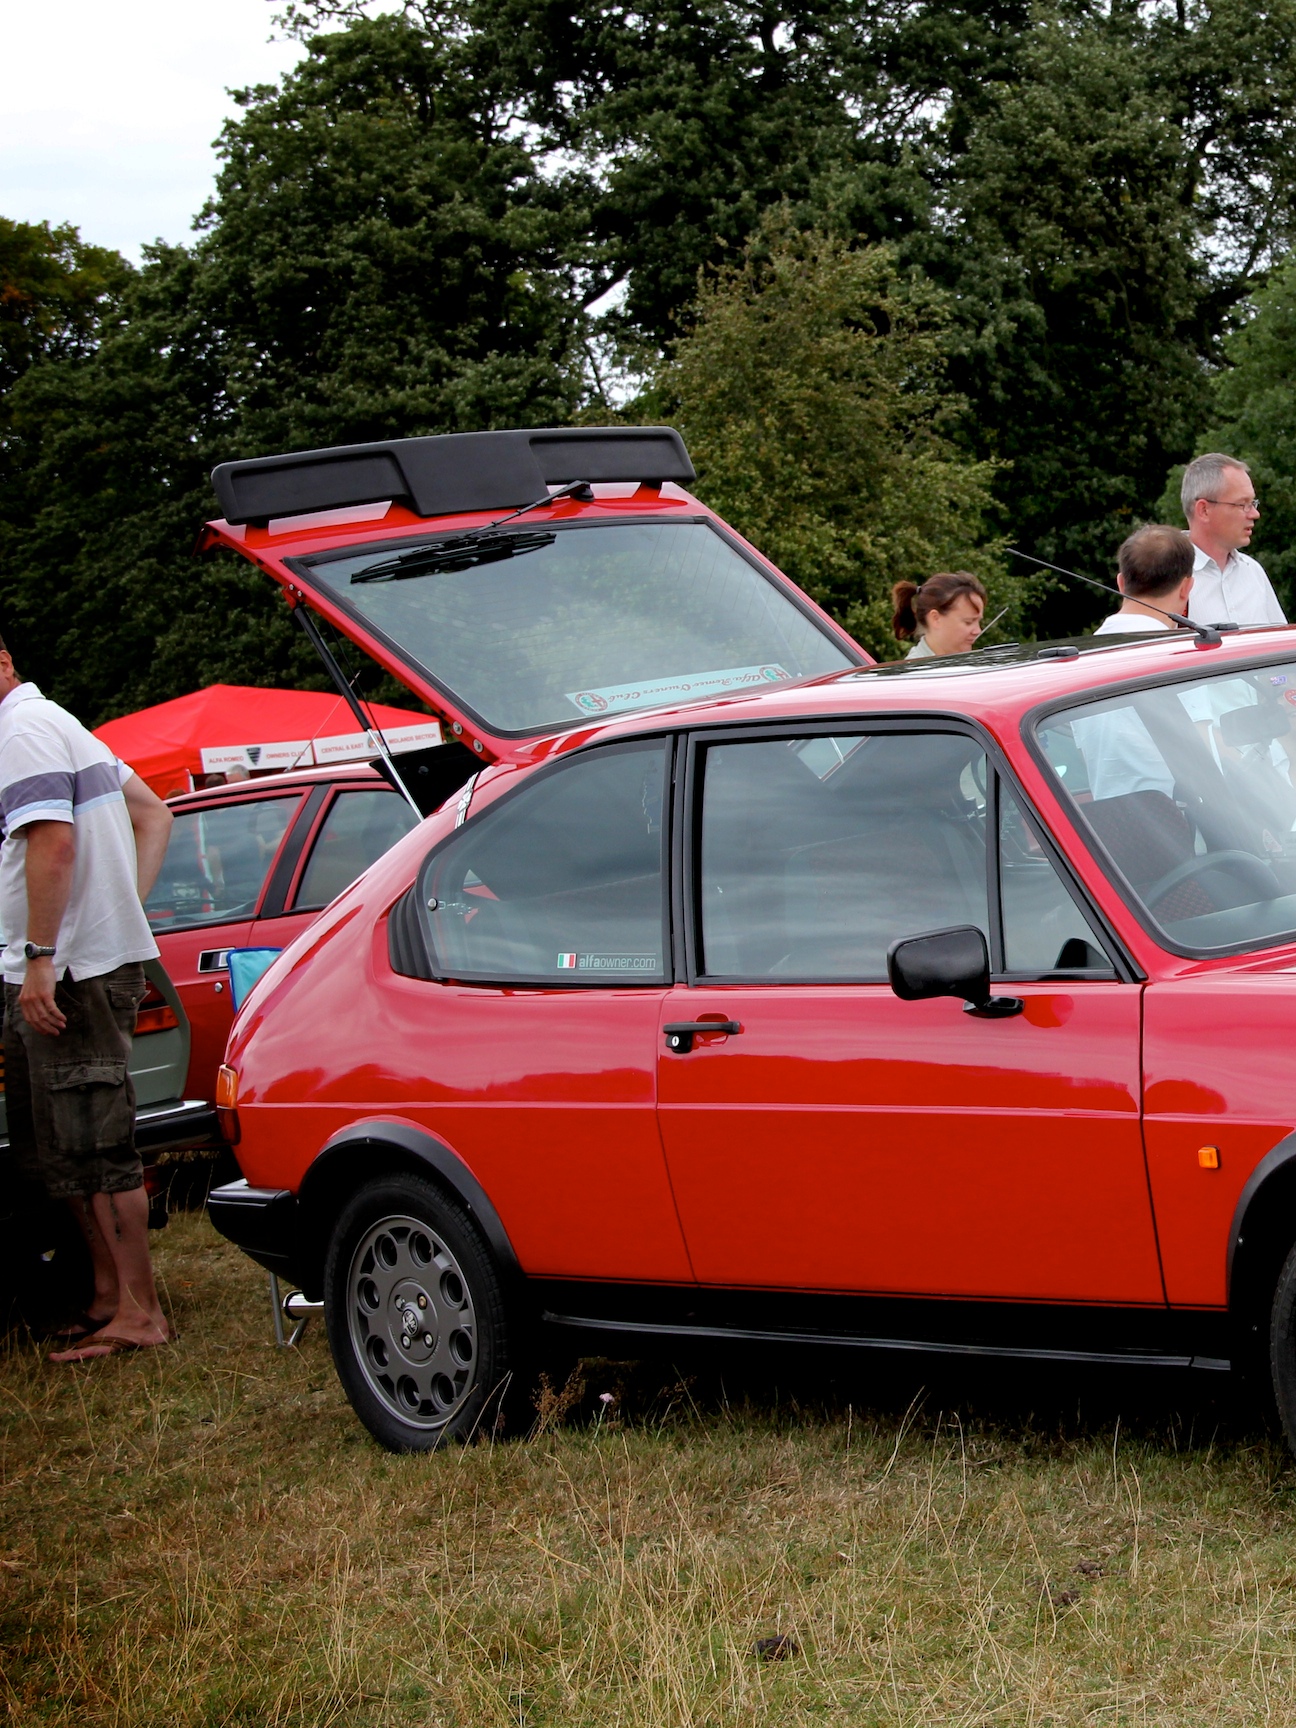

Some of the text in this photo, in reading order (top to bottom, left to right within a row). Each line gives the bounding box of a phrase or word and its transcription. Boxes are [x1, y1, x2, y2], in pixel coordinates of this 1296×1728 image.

[691, 676, 732, 687] Romeo
[643, 683, 691, 694] Owners
[608, 691, 641, 702] Club
[321, 745, 346, 754] CENTRAL
[351, 742, 365, 750] EAST
[388, 735, 415, 745] MIDLANDS
[415, 732, 437, 741] SECTION
[208, 756, 223, 764] ALFA
[223, 755, 244, 763] ROMEO
[265, 751, 289, 760] OWNERS
[579, 954, 656, 968] alfaowner.com
